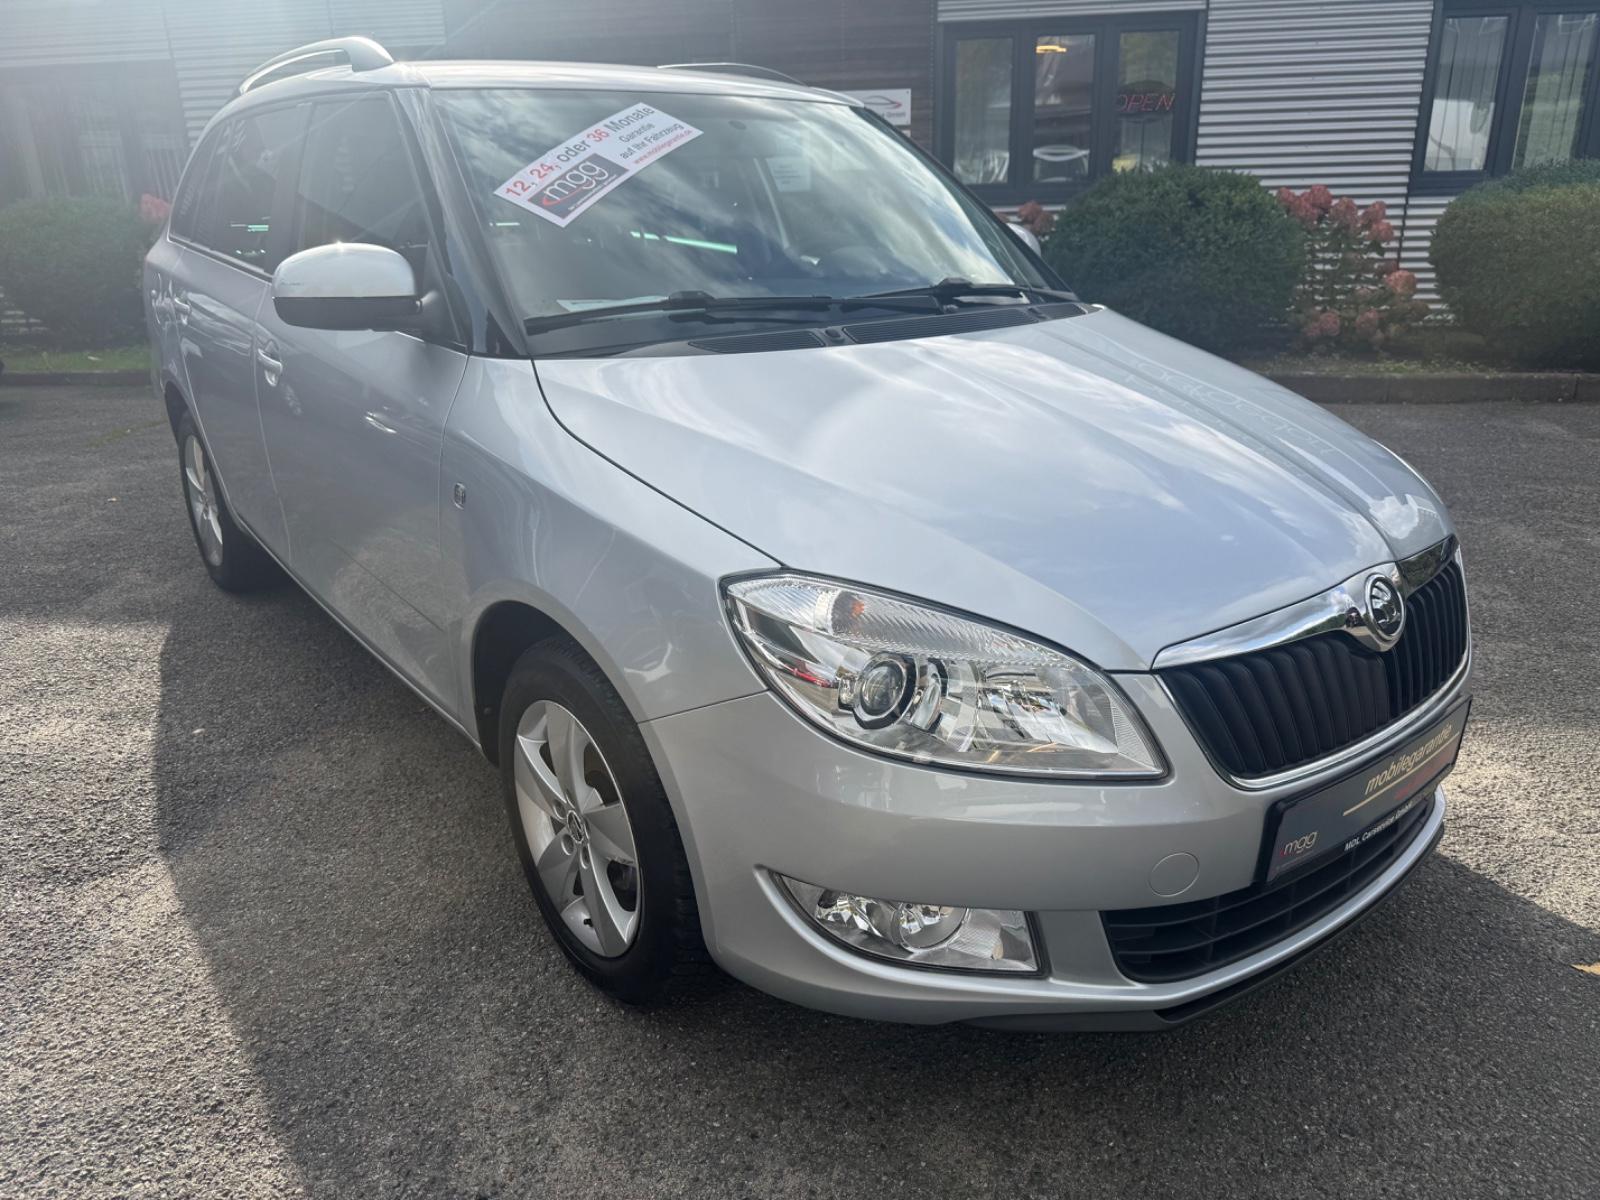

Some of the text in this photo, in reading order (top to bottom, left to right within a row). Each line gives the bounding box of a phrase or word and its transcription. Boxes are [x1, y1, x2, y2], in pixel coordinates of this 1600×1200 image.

[556, 139, 591, 162] oder
[586, 128, 610, 142] 36
[603, 107, 655, 133] Monate
[618, 122, 656, 143] Garantie
[619, 147, 637, 160] auf
[643, 122, 685, 144] Fahrzeug
[543, 161, 609, 200] mgg
[1364, 723, 1453, 795] mobilegarantie
[1283, 830, 1318, 855] mgg
